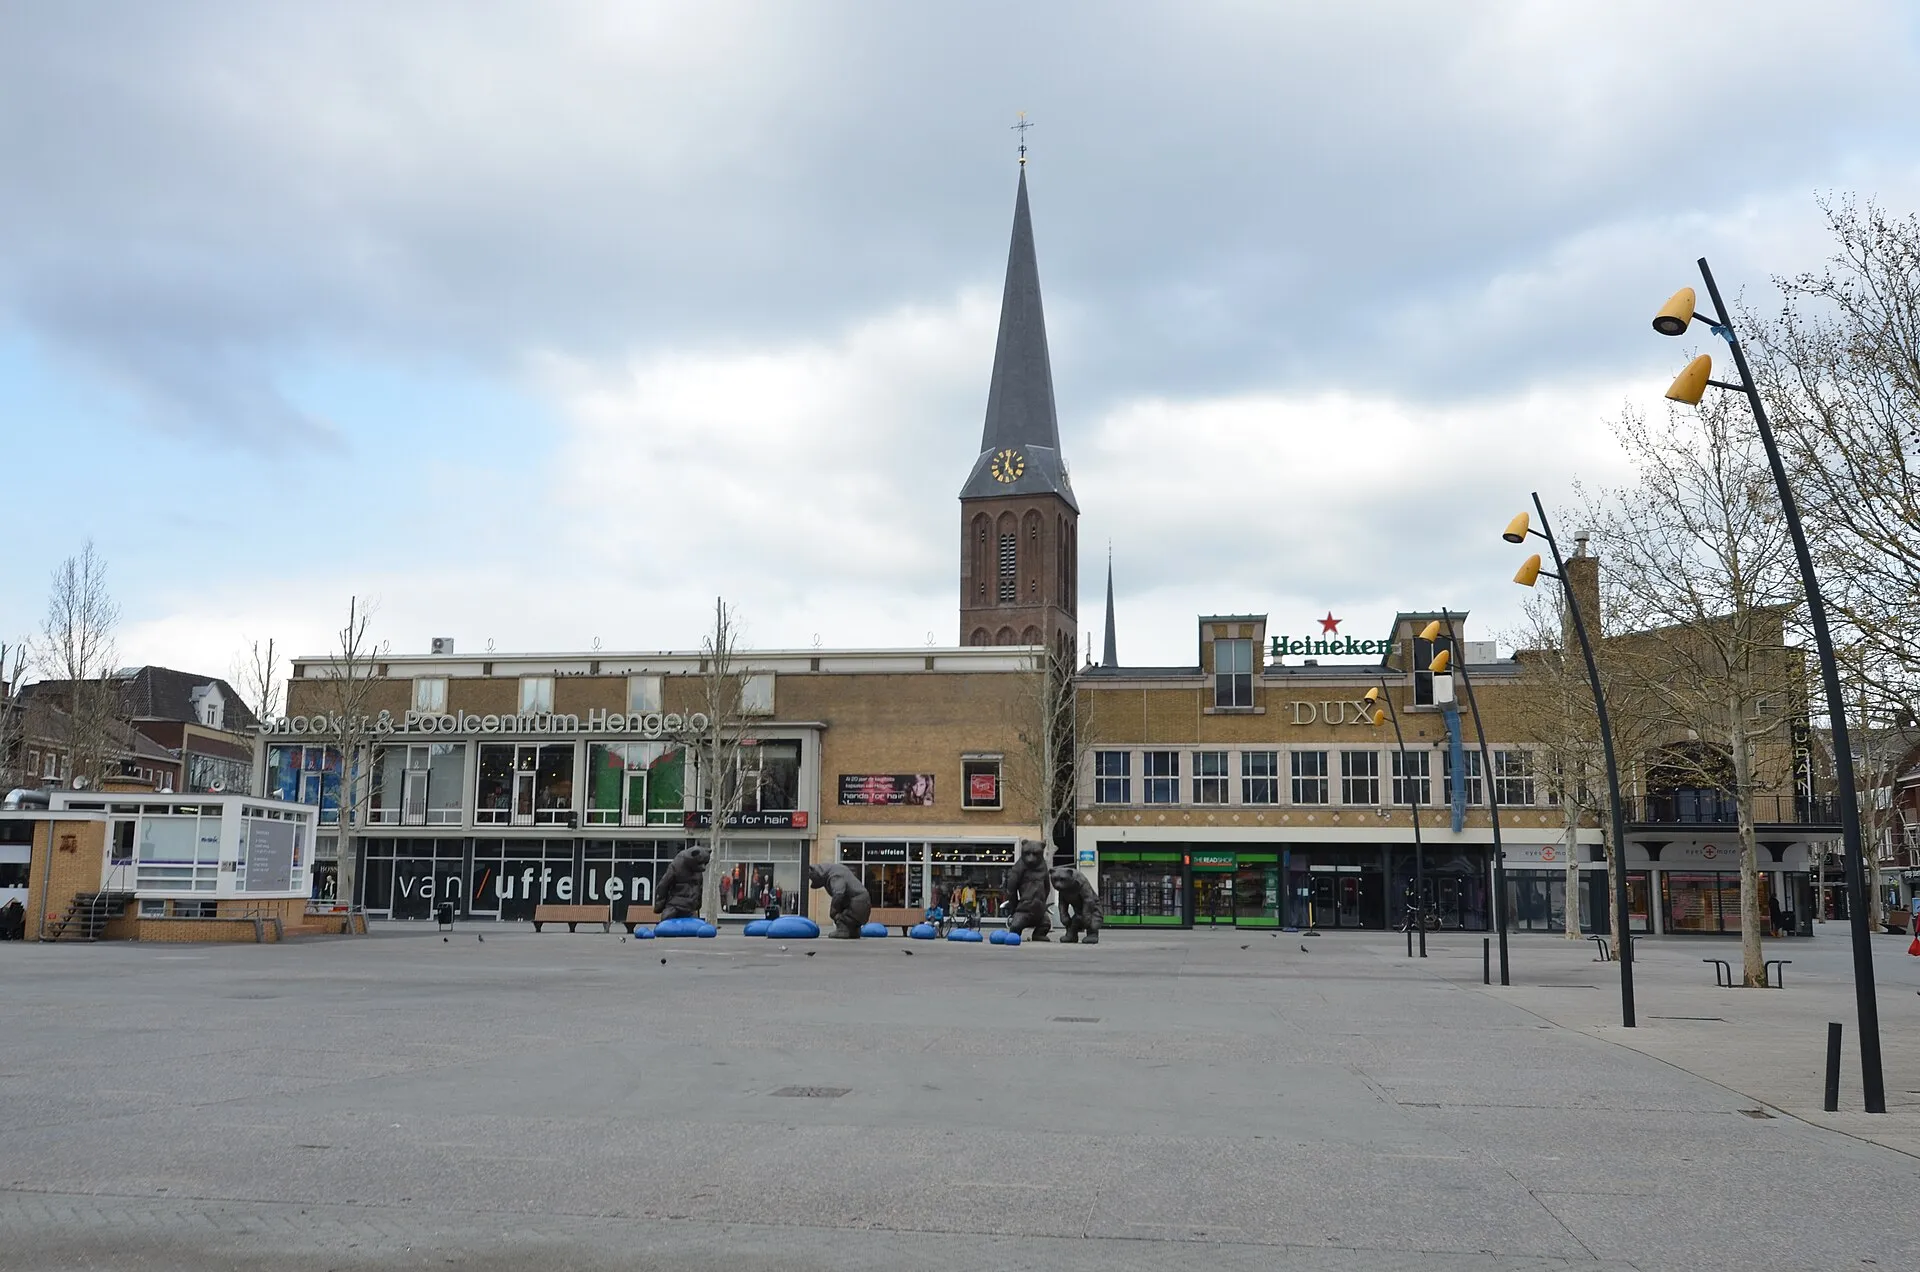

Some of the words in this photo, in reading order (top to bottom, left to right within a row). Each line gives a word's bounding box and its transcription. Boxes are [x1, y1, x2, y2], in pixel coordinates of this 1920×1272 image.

[1271, 635, 1392, 656] Heineken
[374, 709, 395, 735] &
[403, 708, 579, 735] Poolcentrum
[588, 708, 710, 738] Hengelo
[1290, 701, 1375, 725] DUX
[700, 815, 738, 824] has
[741, 815, 761, 824] for
[764, 815, 789, 824] hair
